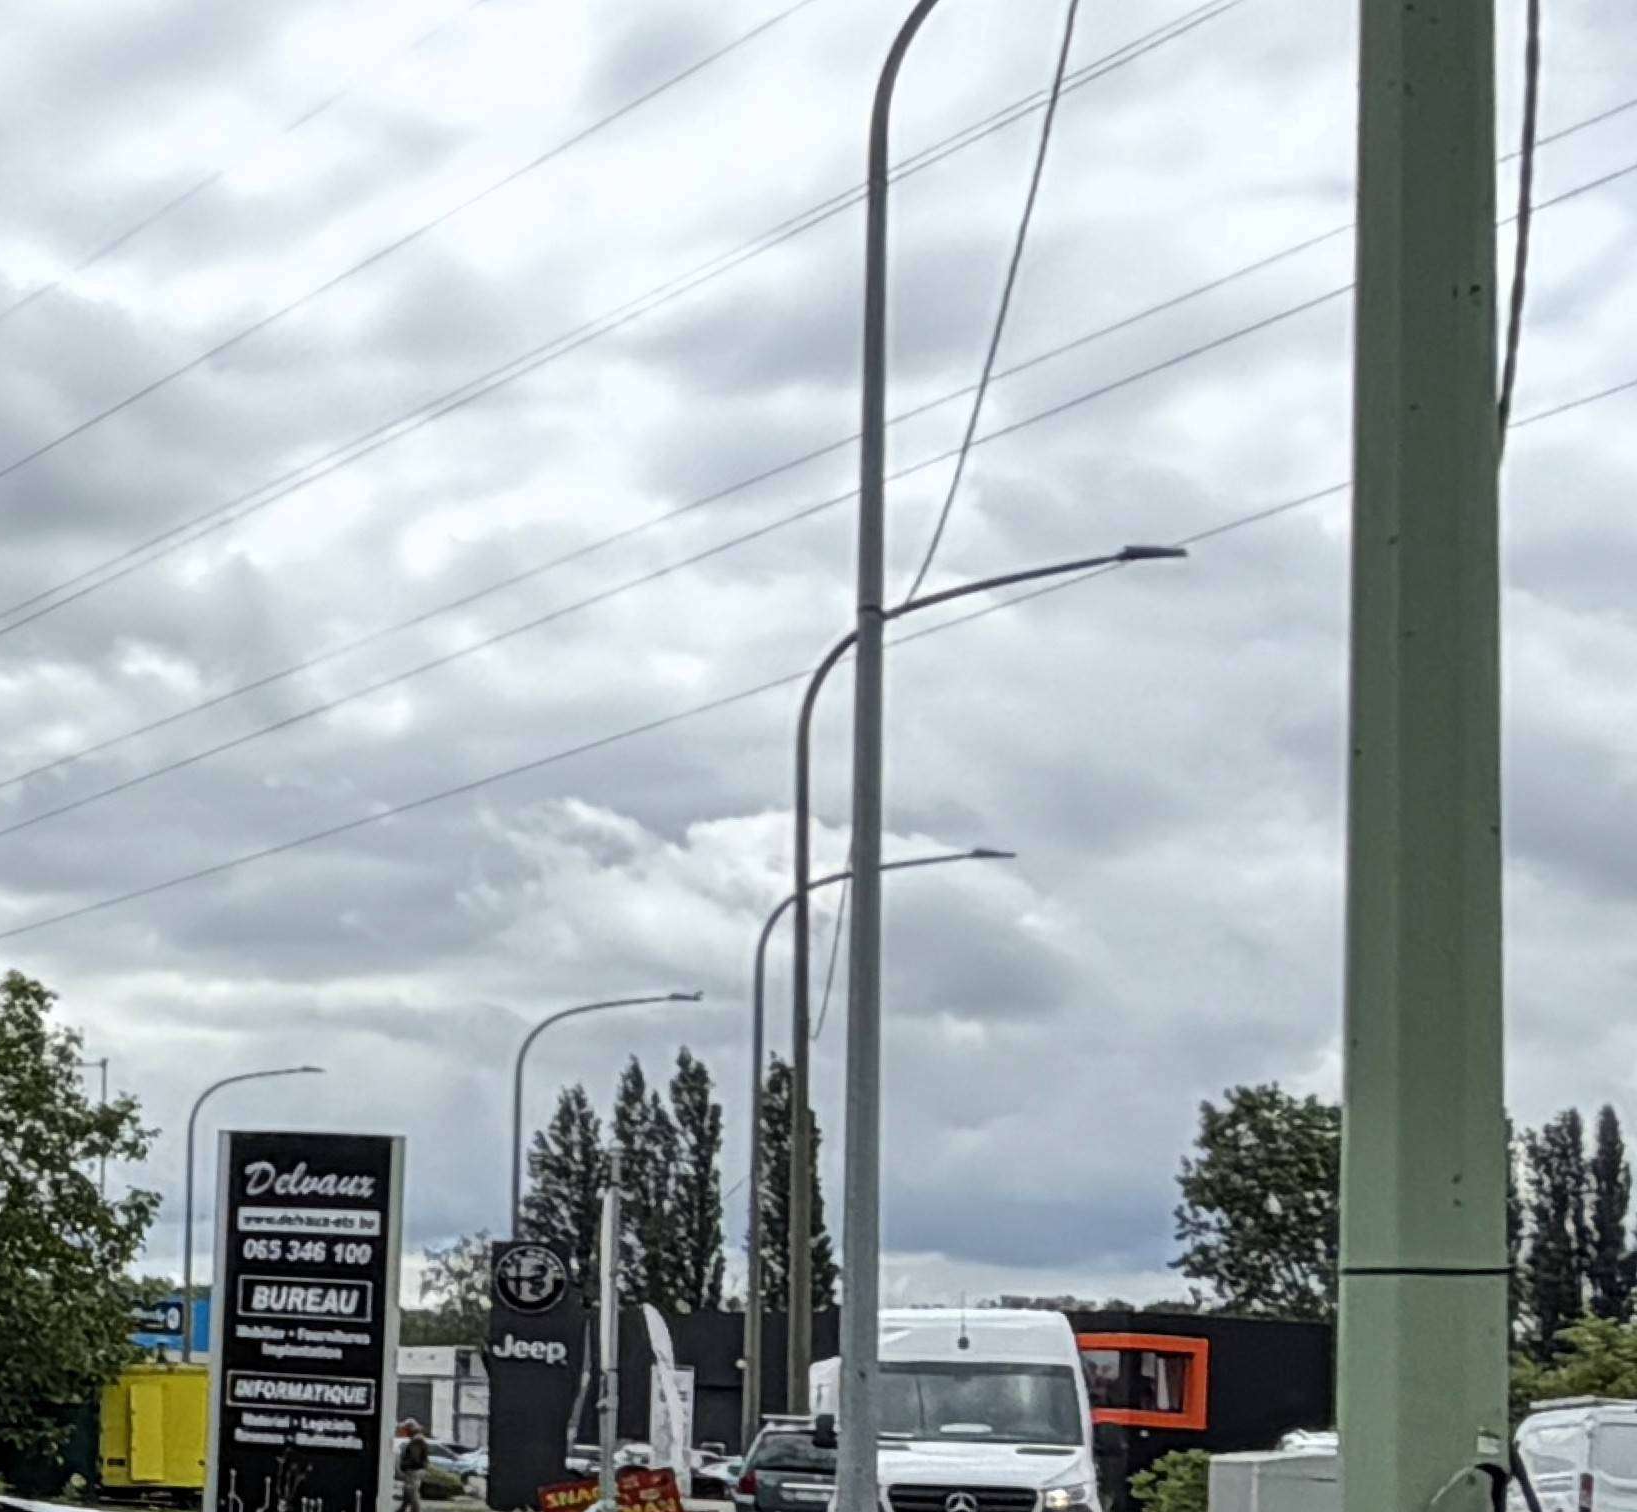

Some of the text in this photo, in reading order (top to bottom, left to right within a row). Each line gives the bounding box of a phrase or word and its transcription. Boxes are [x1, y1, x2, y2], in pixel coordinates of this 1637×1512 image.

[244, 1161, 375, 1198] Delvaux
[243, 1238, 373, 1265] 065 346 100
[251, 1285, 360, 1315] BUREAU
[493, 1333, 567, 1365] Jeep
[234, 1379, 368, 1405] INFORMATIQUE
